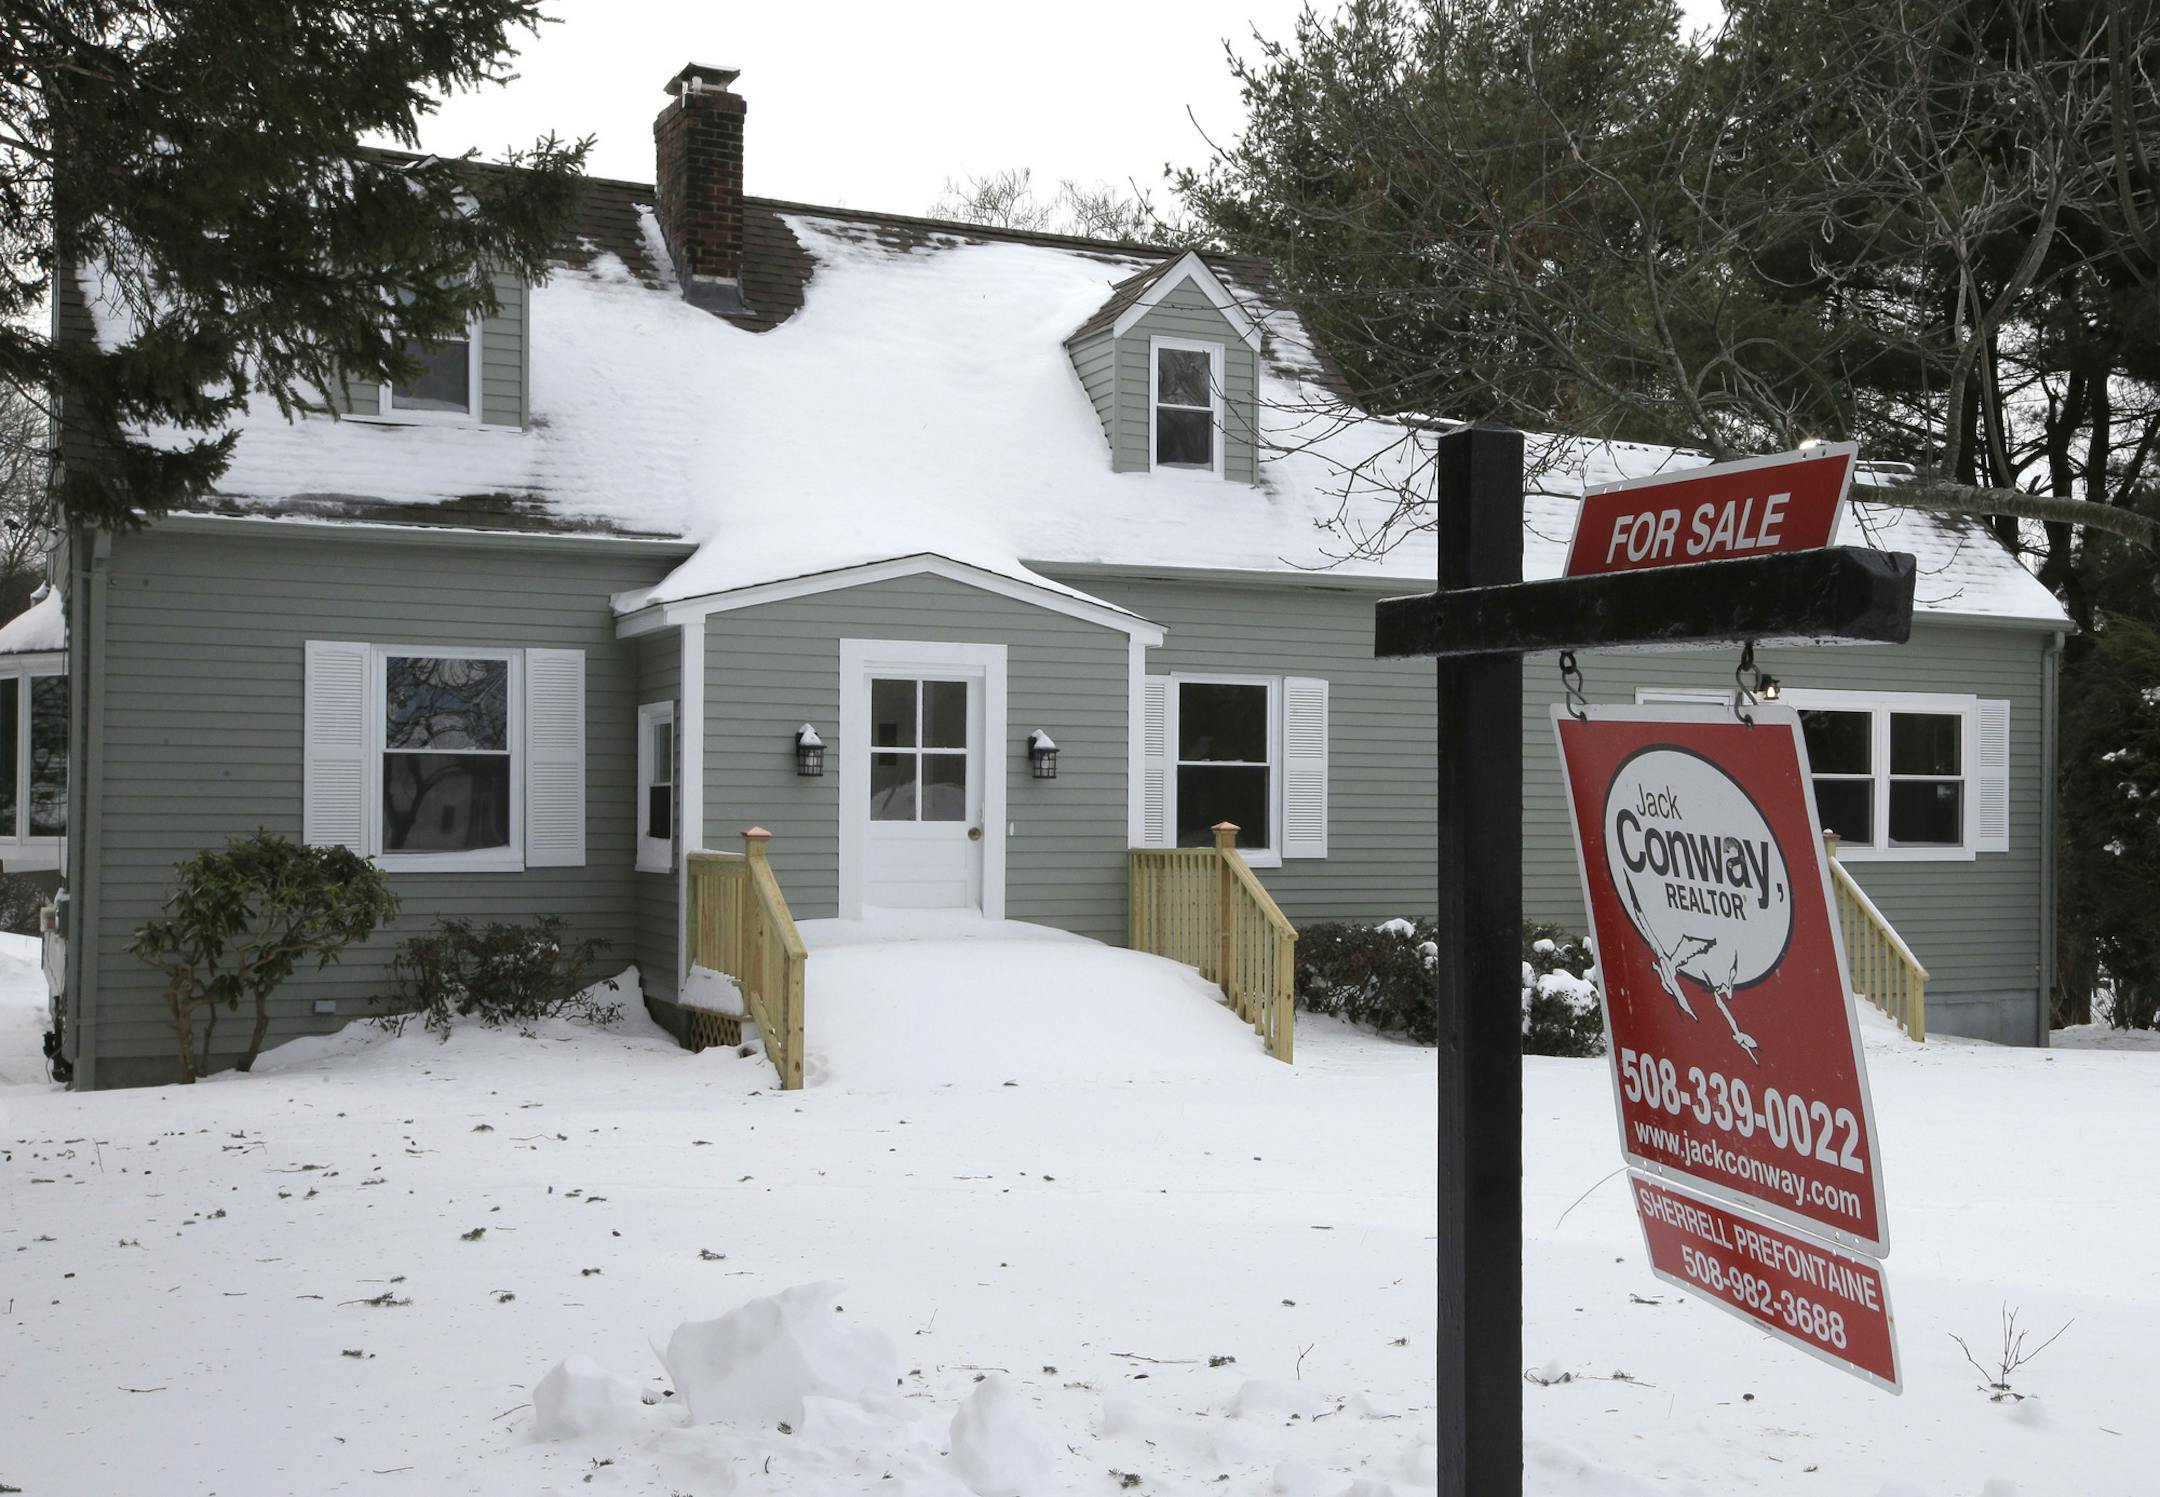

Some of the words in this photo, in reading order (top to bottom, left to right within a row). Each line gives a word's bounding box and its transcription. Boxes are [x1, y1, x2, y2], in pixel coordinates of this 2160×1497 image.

[1606, 508, 1681, 564] FOR
[1686, 492, 1791, 556] SALE
[1636, 783, 1683, 820] Jack
[1664, 882, 1747, 921] REALTOR
[1621, 1047, 1864, 1174] 508-339-0022
[1634, 1120, 1862, 1220] www.jackconway.com
[1639, 1188, 1733, 1250] SHERRELL
[1733, 1223, 1880, 1313] PREFONTAINE
[1681, 1244, 1848, 1350] 508-982-3688
